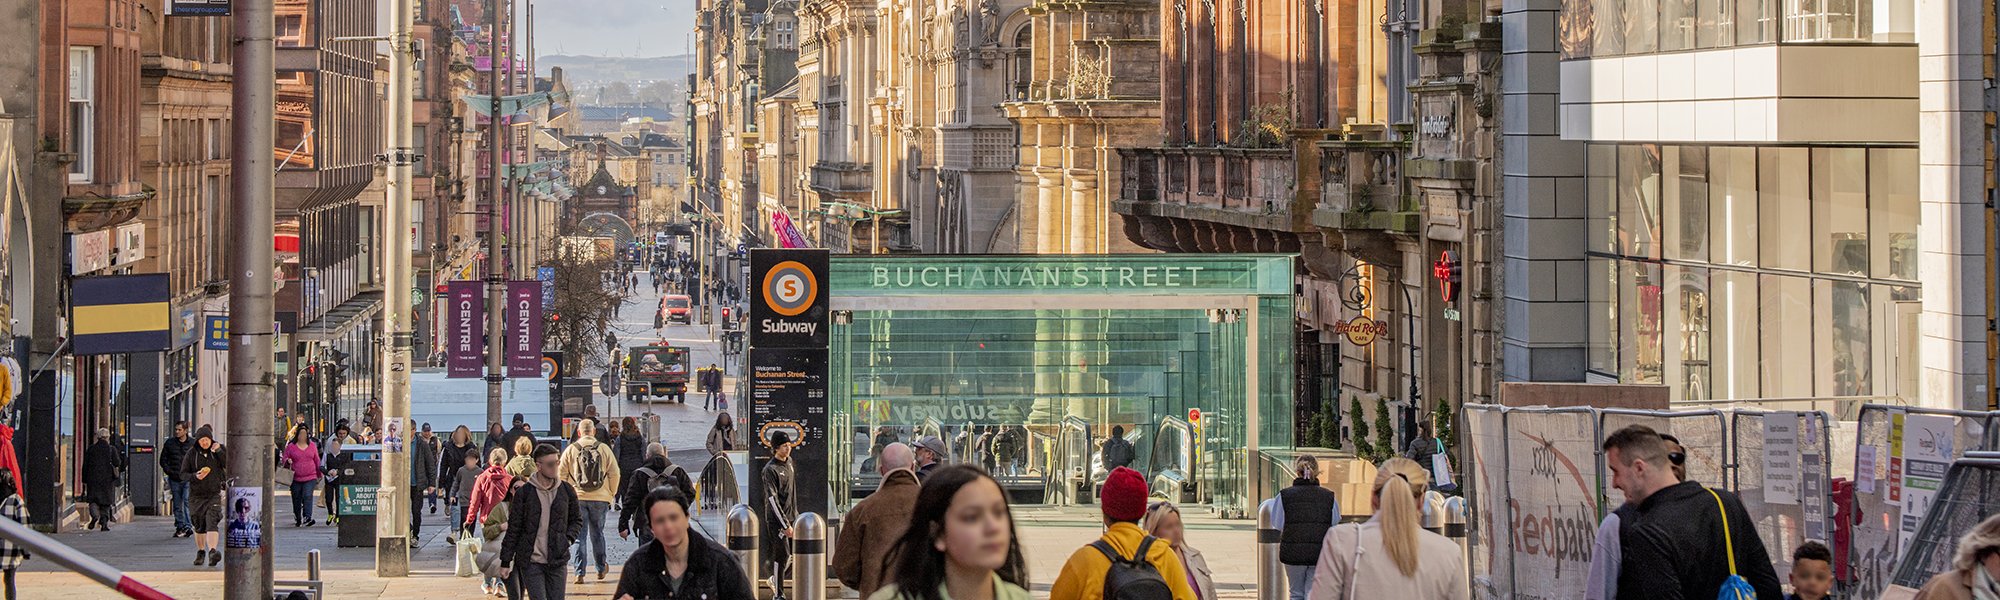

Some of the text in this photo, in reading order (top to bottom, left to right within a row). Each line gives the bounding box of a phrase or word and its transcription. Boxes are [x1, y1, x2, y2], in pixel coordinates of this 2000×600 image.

[873, 266, 1204, 286] BUCHANAN STREET
[783, 279, 797, 297] S
[460, 300, 471, 352] CENTRE
[519, 300, 530, 352] CENTRE
[762, 319, 818, 337] Subway
[1335, 320, 1388, 336] Hard Rock
[1509, 498, 1597, 580] Redpath
